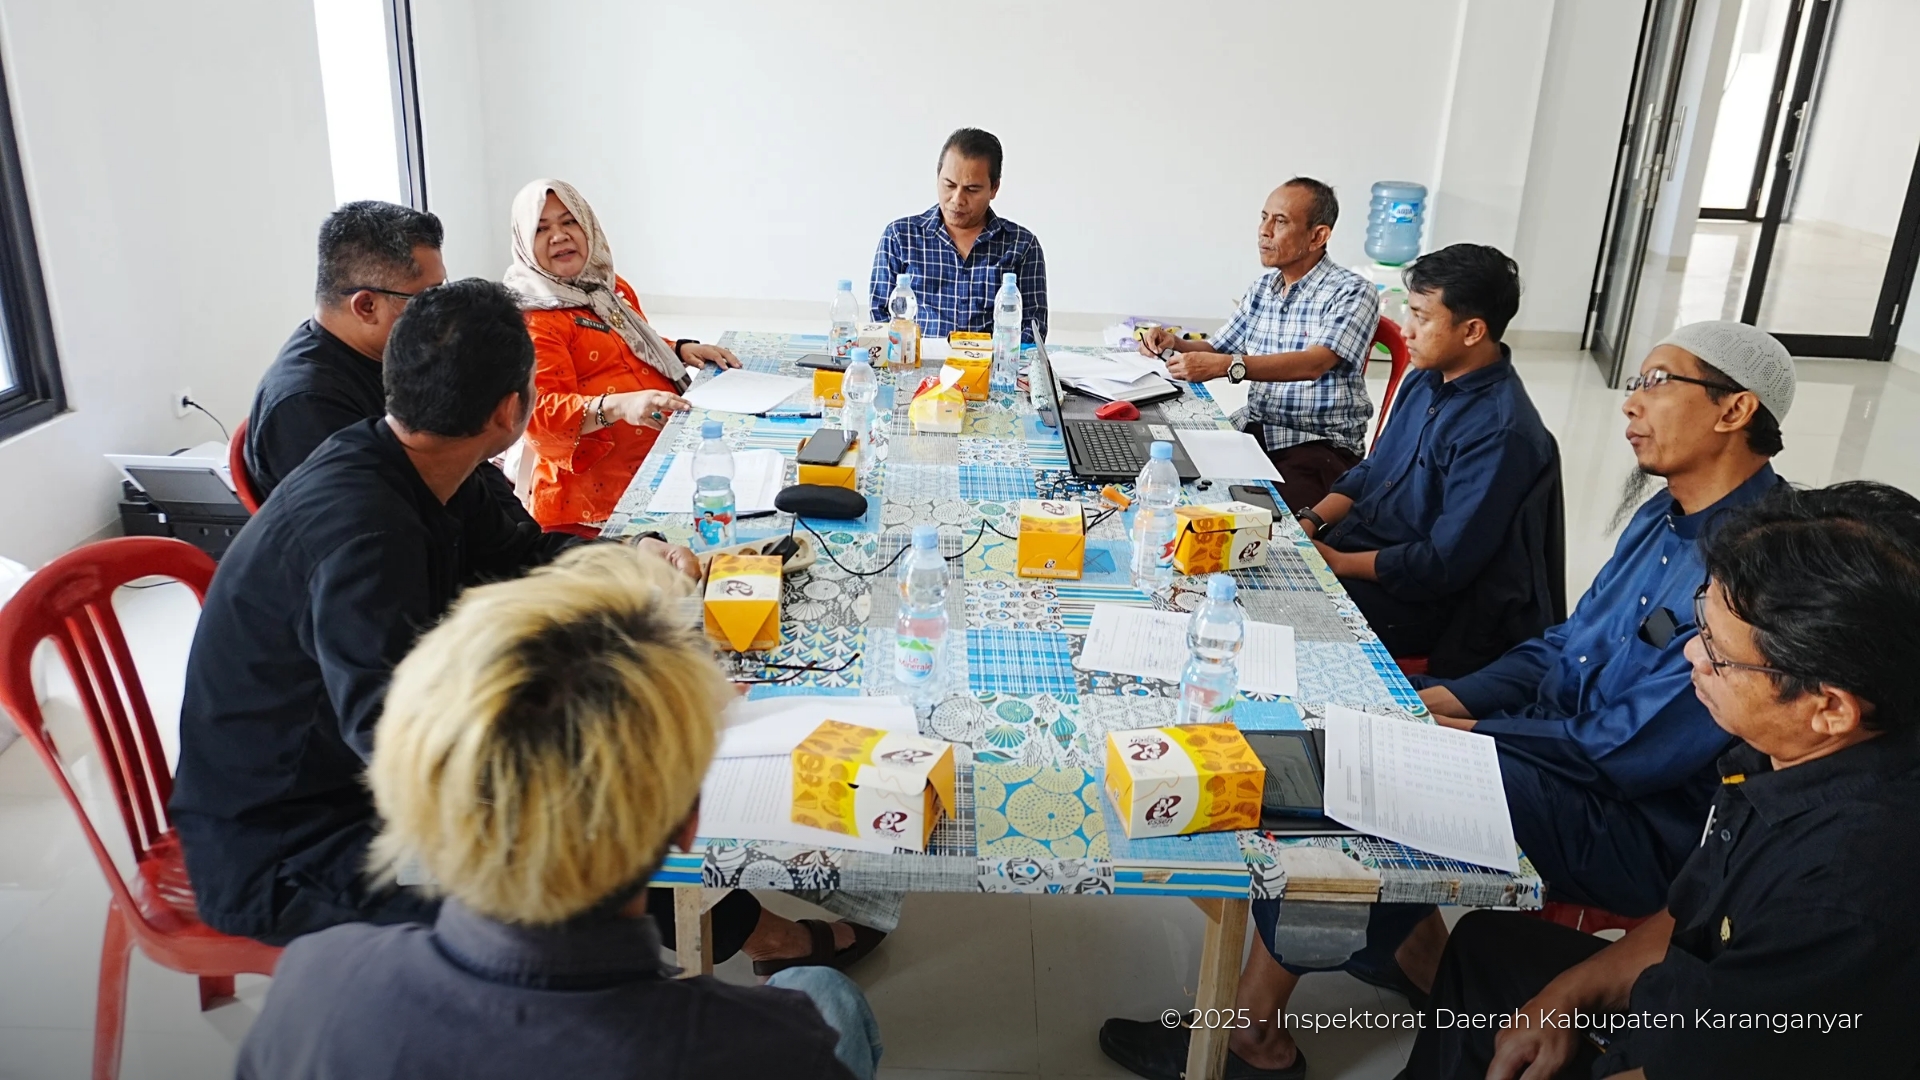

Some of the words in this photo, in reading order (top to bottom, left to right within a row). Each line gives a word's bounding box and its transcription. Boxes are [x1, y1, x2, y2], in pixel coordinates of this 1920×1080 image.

[909, 654, 918, 663] Le
[898, 657, 934, 670] Minerale
[1147, 817, 1174, 826] essen
